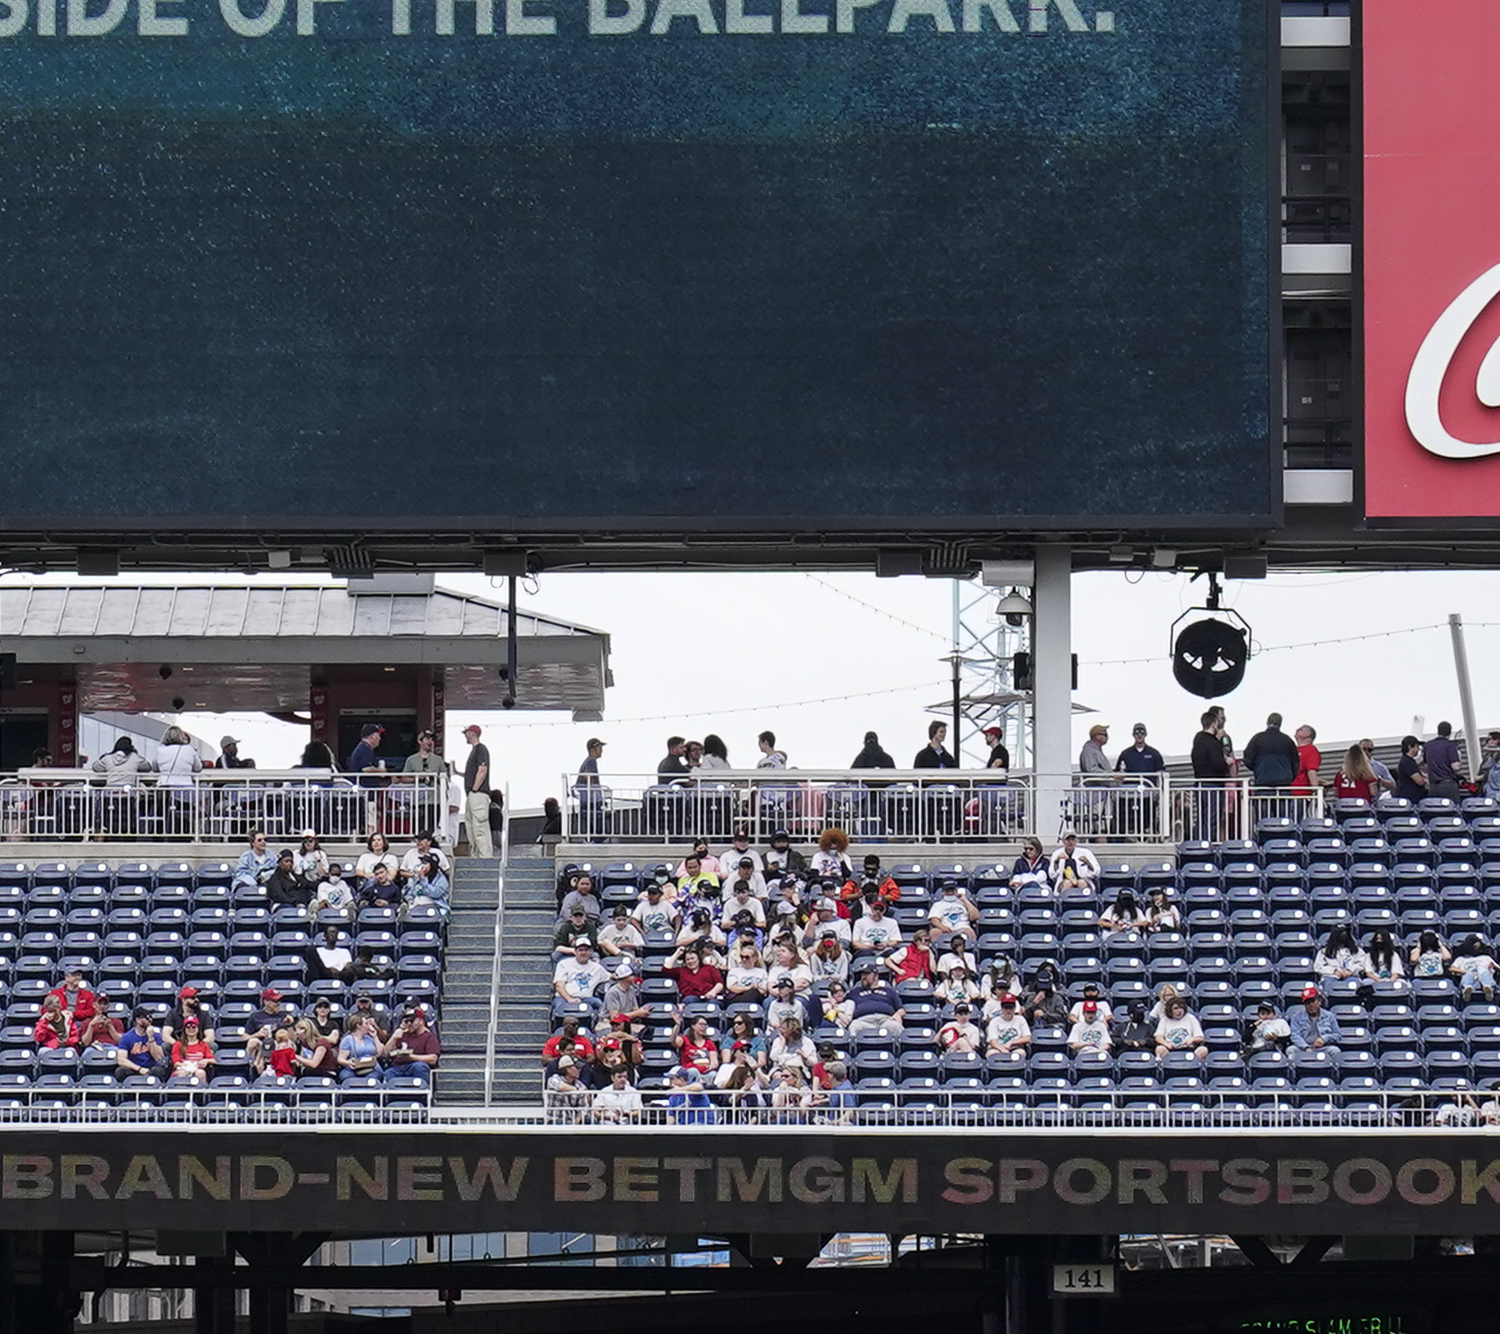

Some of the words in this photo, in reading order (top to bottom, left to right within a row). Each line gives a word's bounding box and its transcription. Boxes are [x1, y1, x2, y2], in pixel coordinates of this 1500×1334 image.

[1, 1155, 530, 1204] BRAND-NEW
[554, 1156, 920, 1204] BETMGM
[1064, 1269, 1105, 1288] 141
